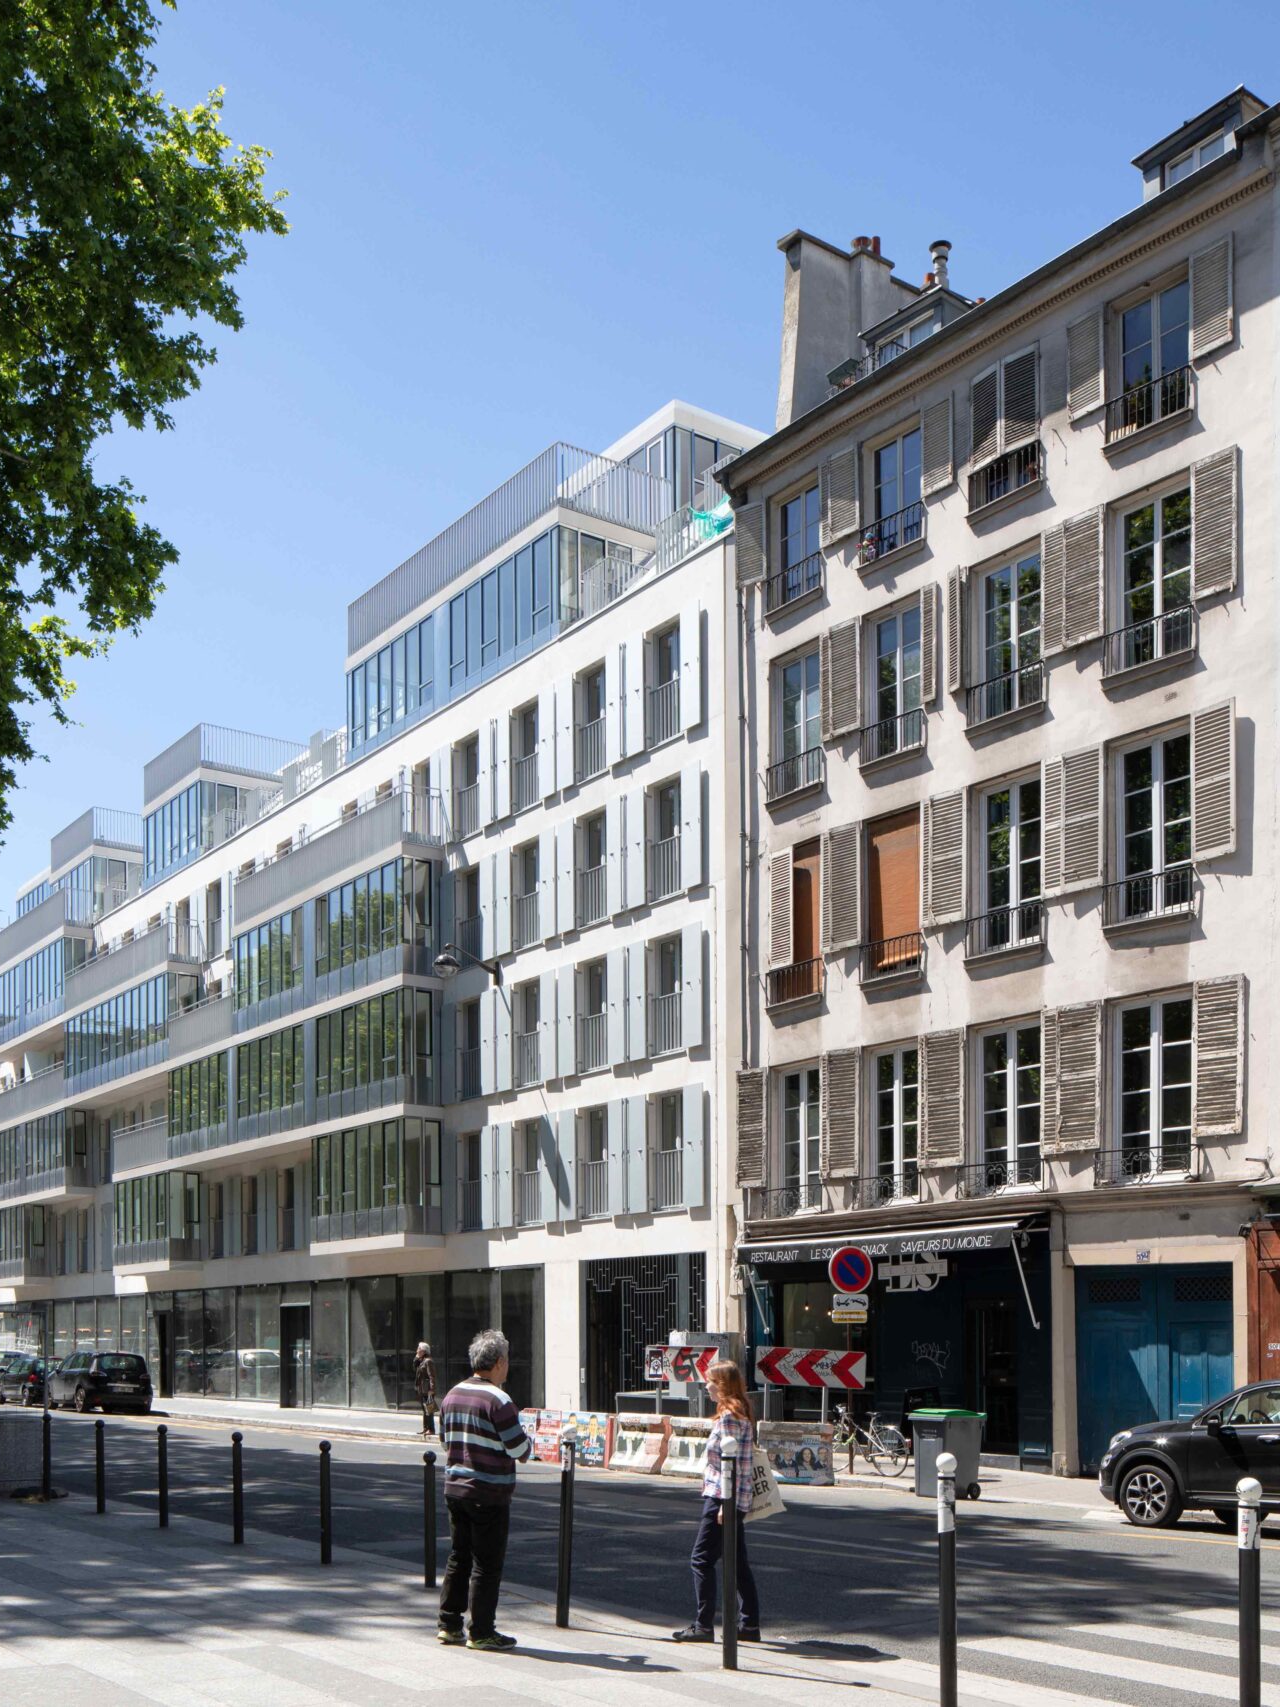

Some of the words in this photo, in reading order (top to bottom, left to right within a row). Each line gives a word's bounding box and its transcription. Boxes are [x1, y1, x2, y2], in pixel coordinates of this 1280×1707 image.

[750, 1250, 799, 1263] RESTAURANT
[810, 1249, 821, 1260] LE
[900, 1239, 941, 1253] SAVEURS
[941, 1238, 956, 1250] DU
[957, 1235, 993, 1249] MONDE
